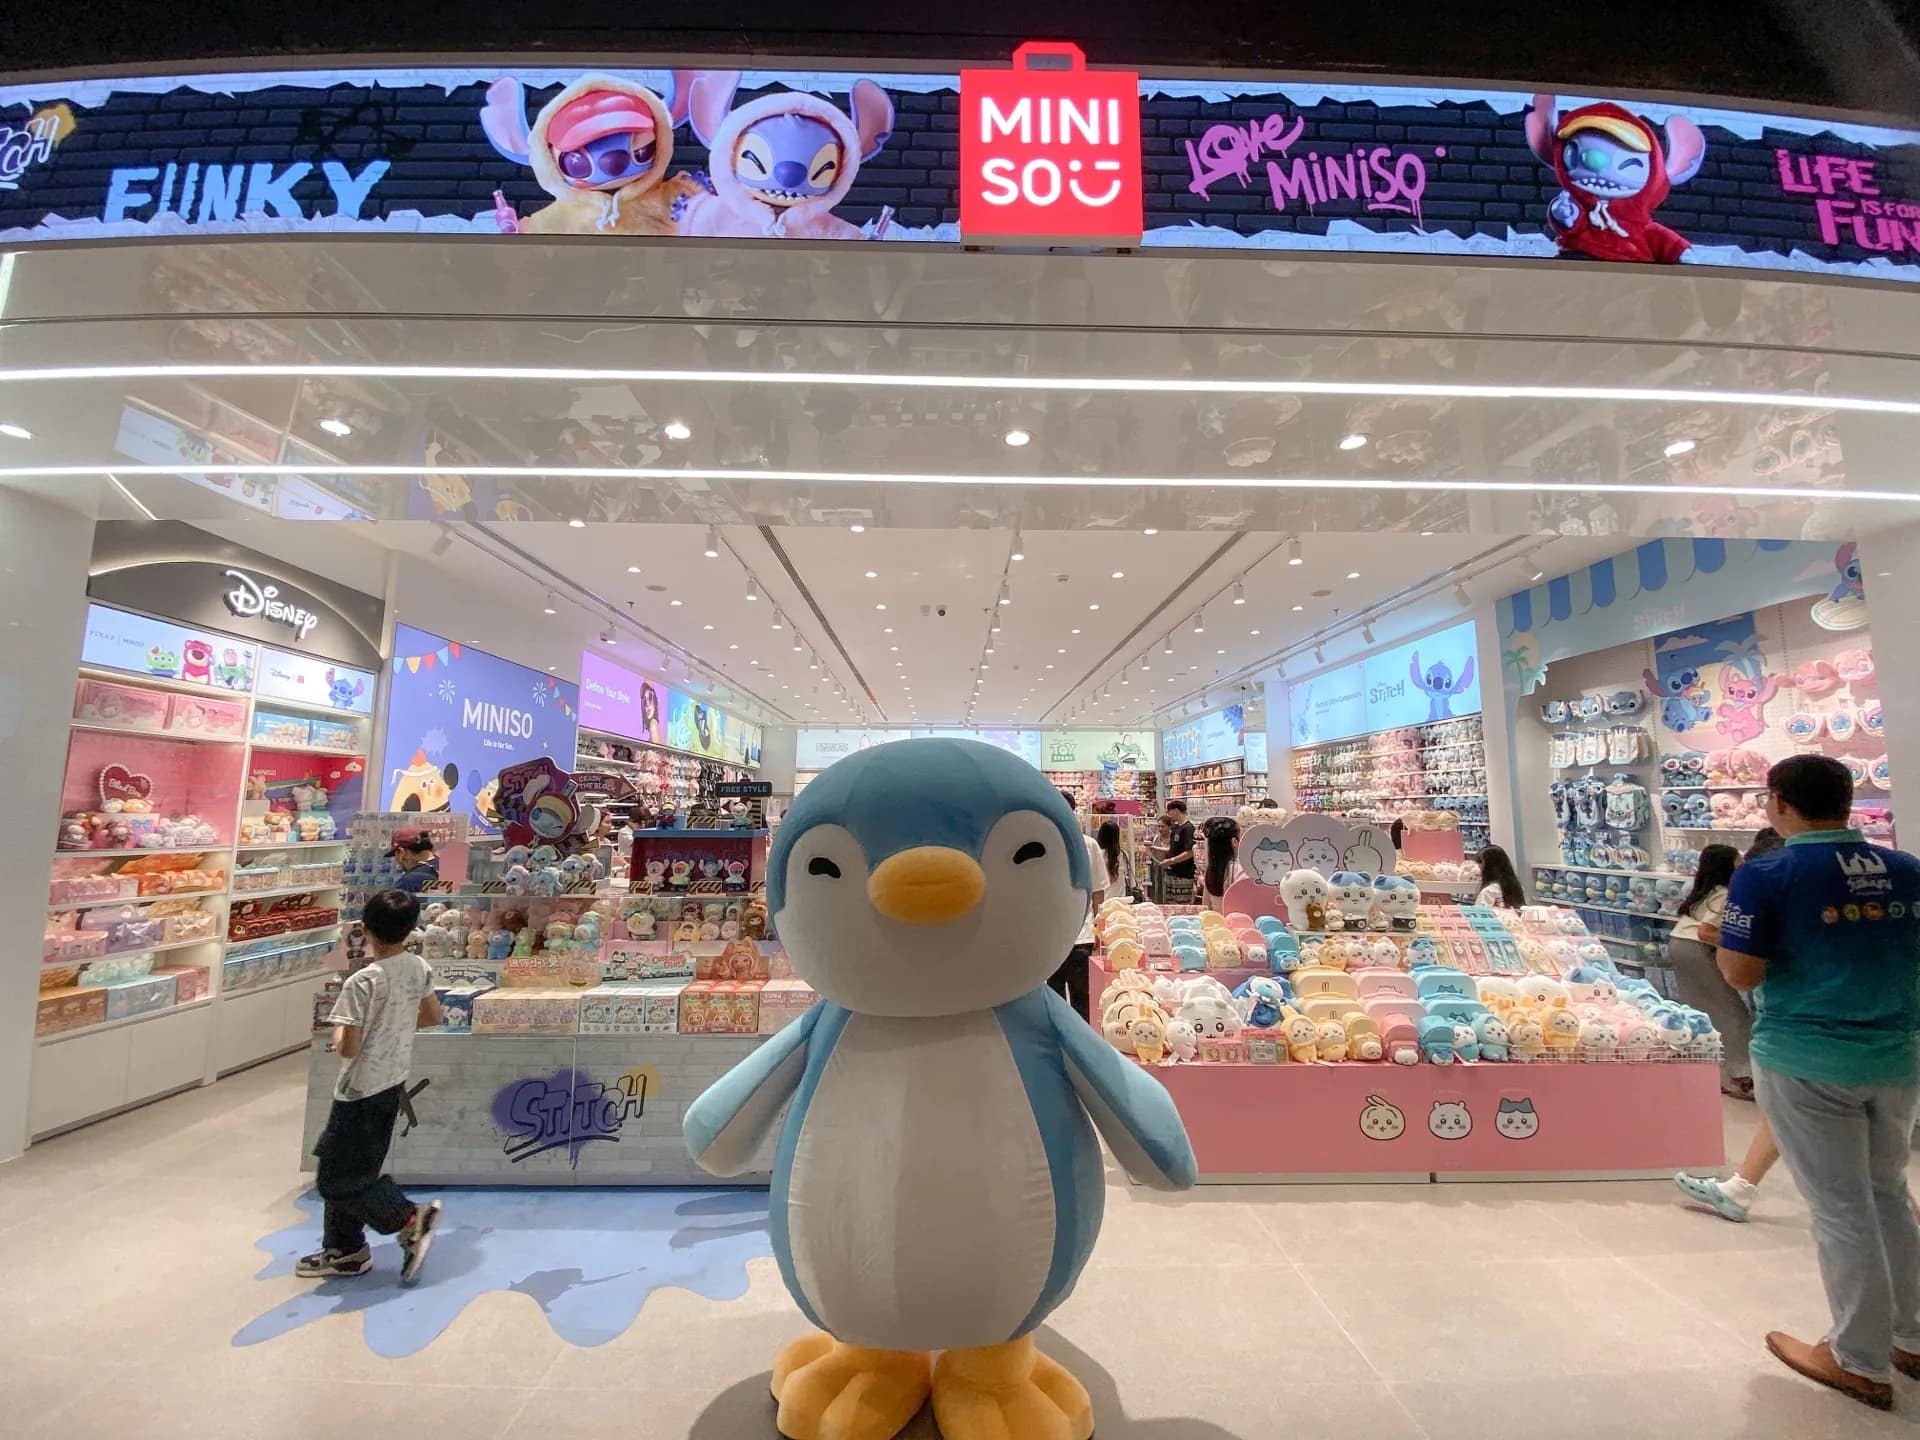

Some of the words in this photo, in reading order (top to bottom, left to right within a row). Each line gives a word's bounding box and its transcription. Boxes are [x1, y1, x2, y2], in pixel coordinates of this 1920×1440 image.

[980, 96, 1121, 145] MINI
[1775, 149, 1880, 194] LIFE
[1861, 199, 1881, 215] IS
[462, 698, 533, 739] MINISO
